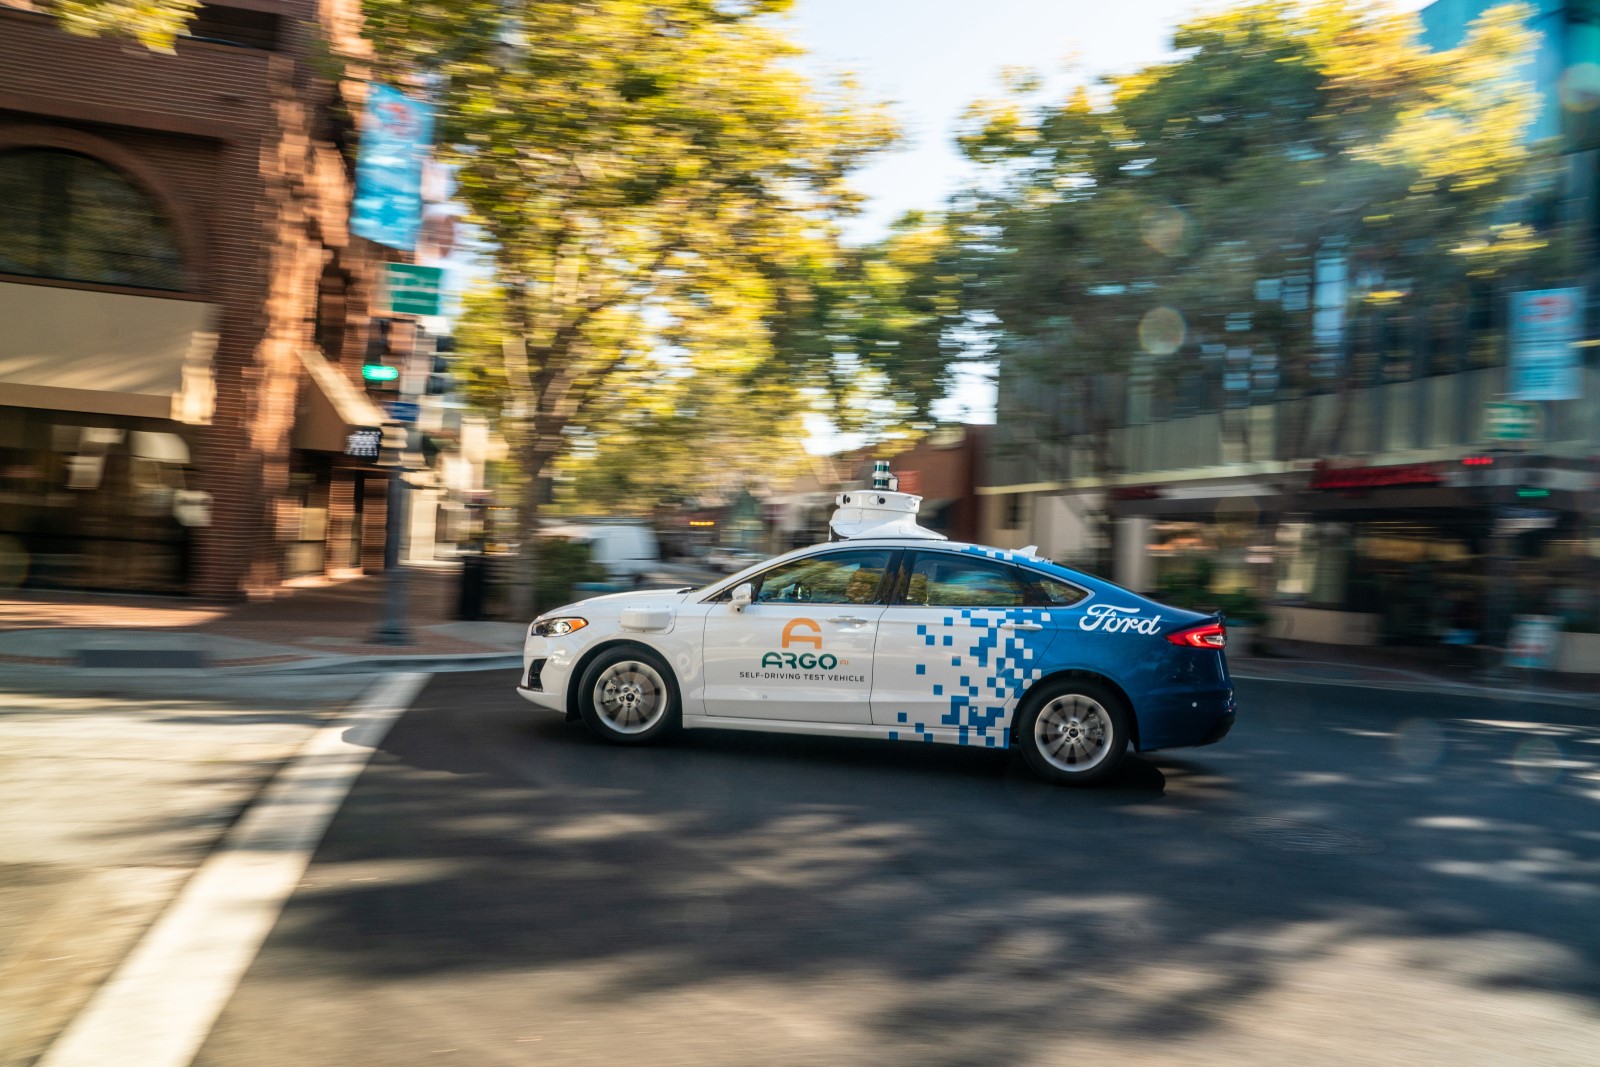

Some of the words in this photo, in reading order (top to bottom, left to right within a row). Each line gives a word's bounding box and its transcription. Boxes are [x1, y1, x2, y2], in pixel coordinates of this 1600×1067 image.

[1079, 603, 1161, 635] Ford
[762, 652, 837, 670] ARGO
[739, 671, 801, 680] SELF-DRIVING
[803, 673, 825, 681] TEST
[828, 674, 865, 682] VEHICLE
